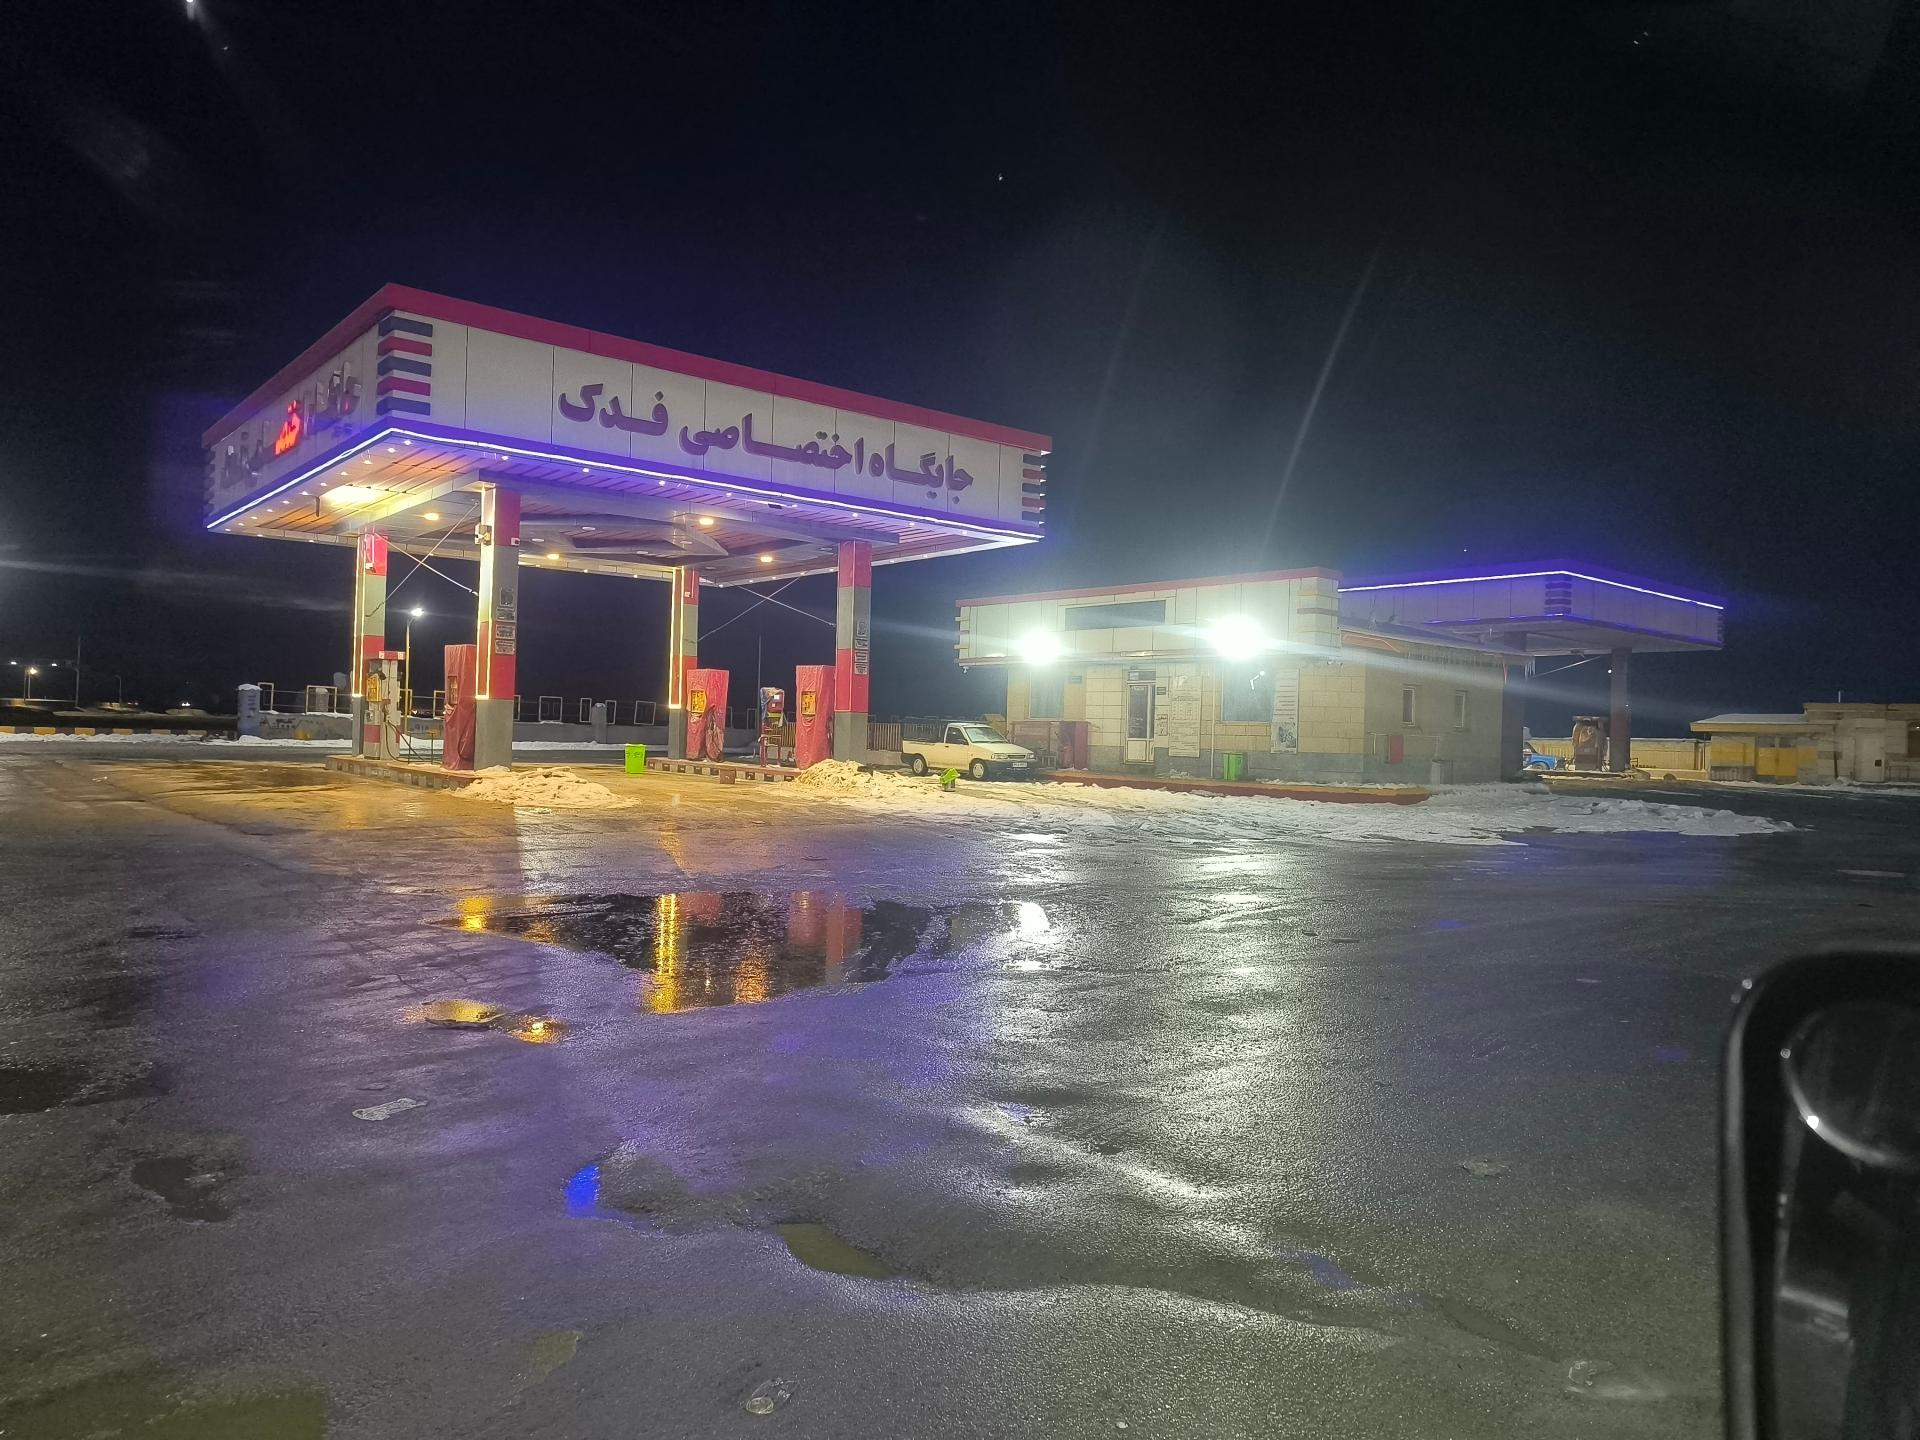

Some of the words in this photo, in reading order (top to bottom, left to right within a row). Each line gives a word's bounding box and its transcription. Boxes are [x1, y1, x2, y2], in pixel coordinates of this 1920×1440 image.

[558, 382, 669, 437] فدک
[679, 413, 865, 475] اختصاصی
[870, 442, 975, 505] جایگاه
